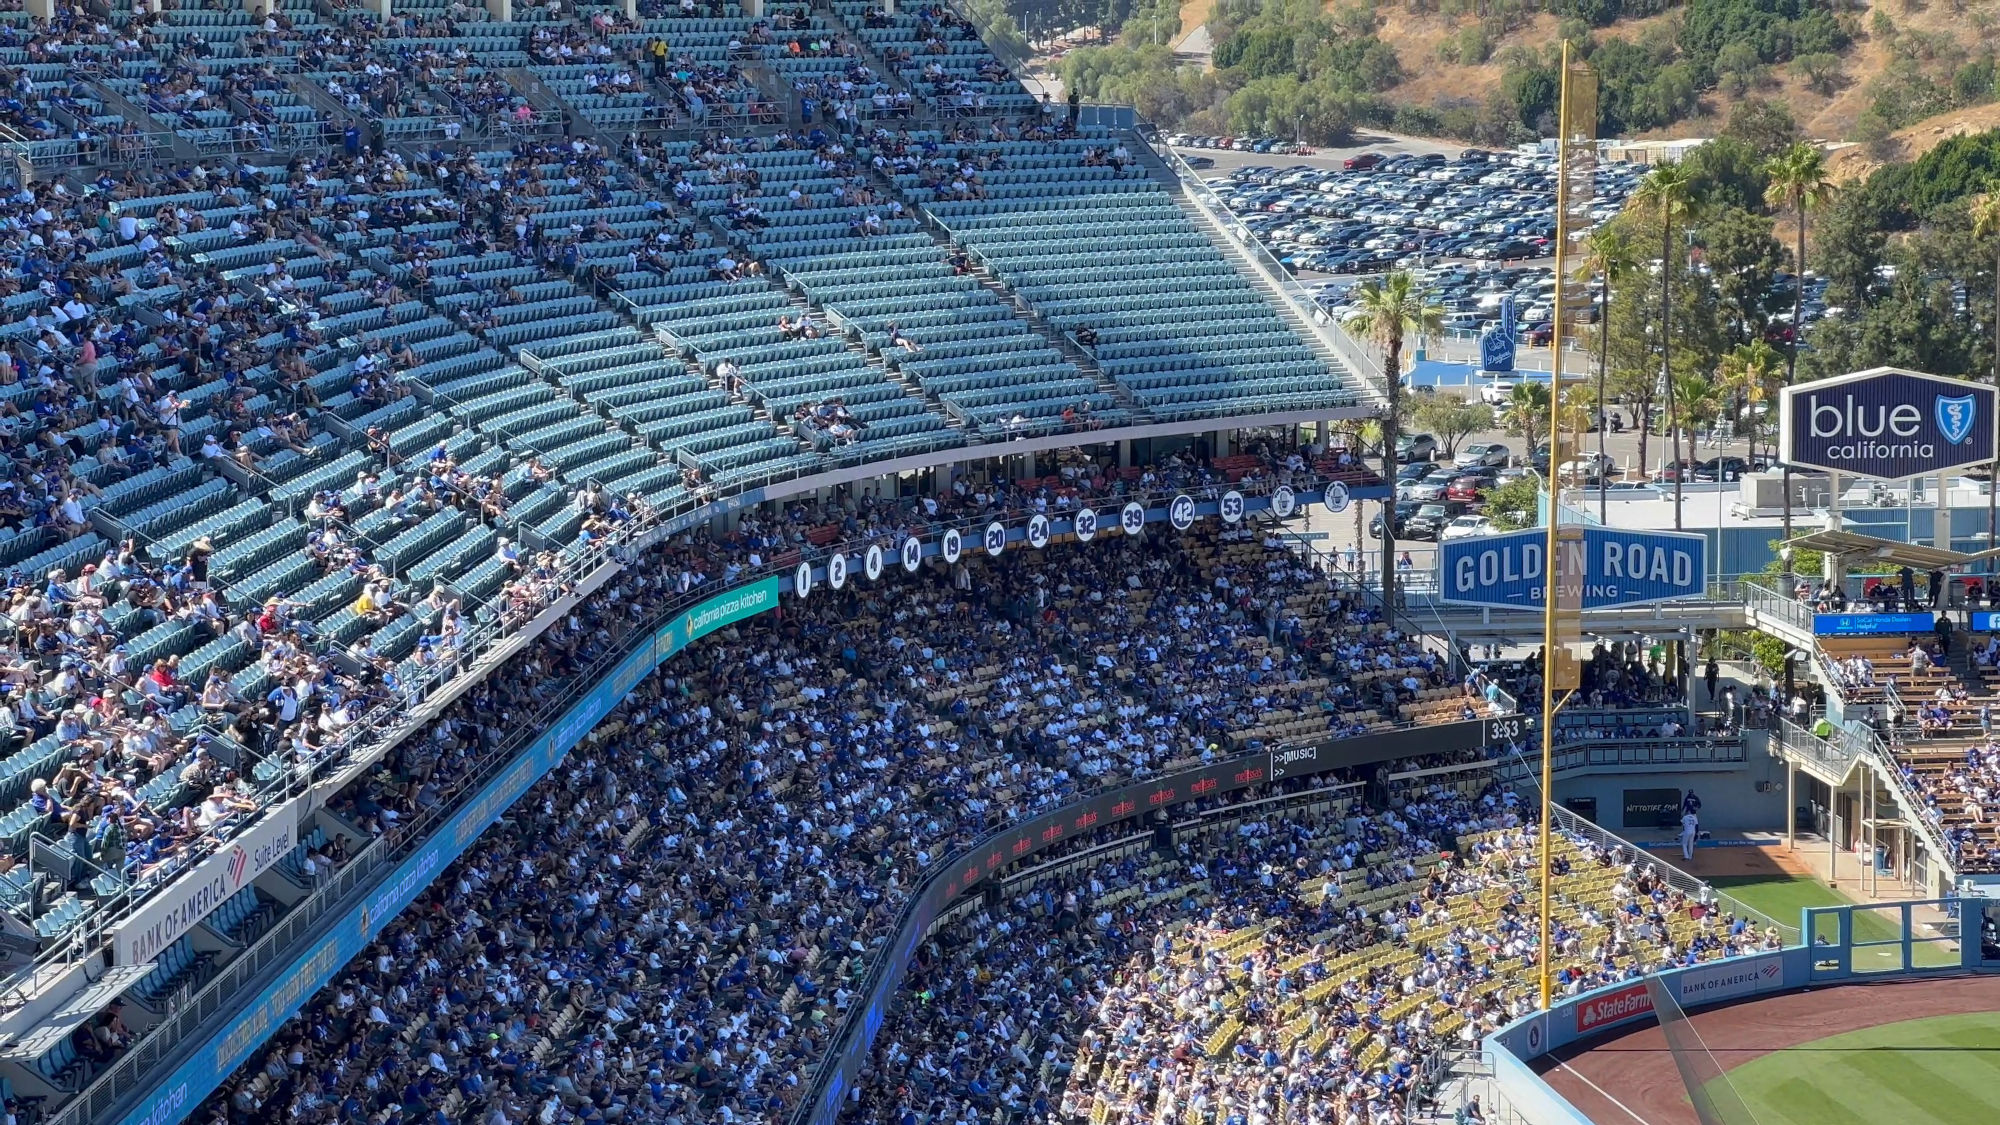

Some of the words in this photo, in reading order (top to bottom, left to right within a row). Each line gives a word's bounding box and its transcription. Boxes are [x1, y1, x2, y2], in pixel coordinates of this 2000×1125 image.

[1488, 351, 1512, 366] Dodgers
[1811, 395, 1921, 437] blue
[1827, 440, 1934, 459] california
[1174, 503, 1192, 522] 42
[1224, 497, 1242, 516] 53
[1078, 516, 1095, 535] 32
[1124, 510, 1142, 528] 39
[988, 529, 1003, 549] 20
[1031, 523, 1047, 541] 24
[907, 544, 918, 564] 14
[947, 536, 958, 555] 19
[834, 561, 842, 581] 2
[870, 553, 877, 572] 4
[1604, 541, 1692, 587] ROAD
[1530, 584, 1618, 599] BEWING
[694, 605, 720, 630] california
[720, 600, 739, 620] pizza
[741, 590, 767, 609] kitchen
[1491, 721, 1519, 740] 3:53
[253, 844, 272, 872] Suite
[272, 826, 289, 857] Level
[132, 920, 162, 965] BANK
[165, 910, 179, 940] OF
[181, 874, 226, 926] AMERICA
[1683, 982, 1706, 995] BANK
[1708, 979, 1719, 989] OF
[1721, 972, 1760, 987] AMERICA
[152, 1082, 188, 1125] kitchen
